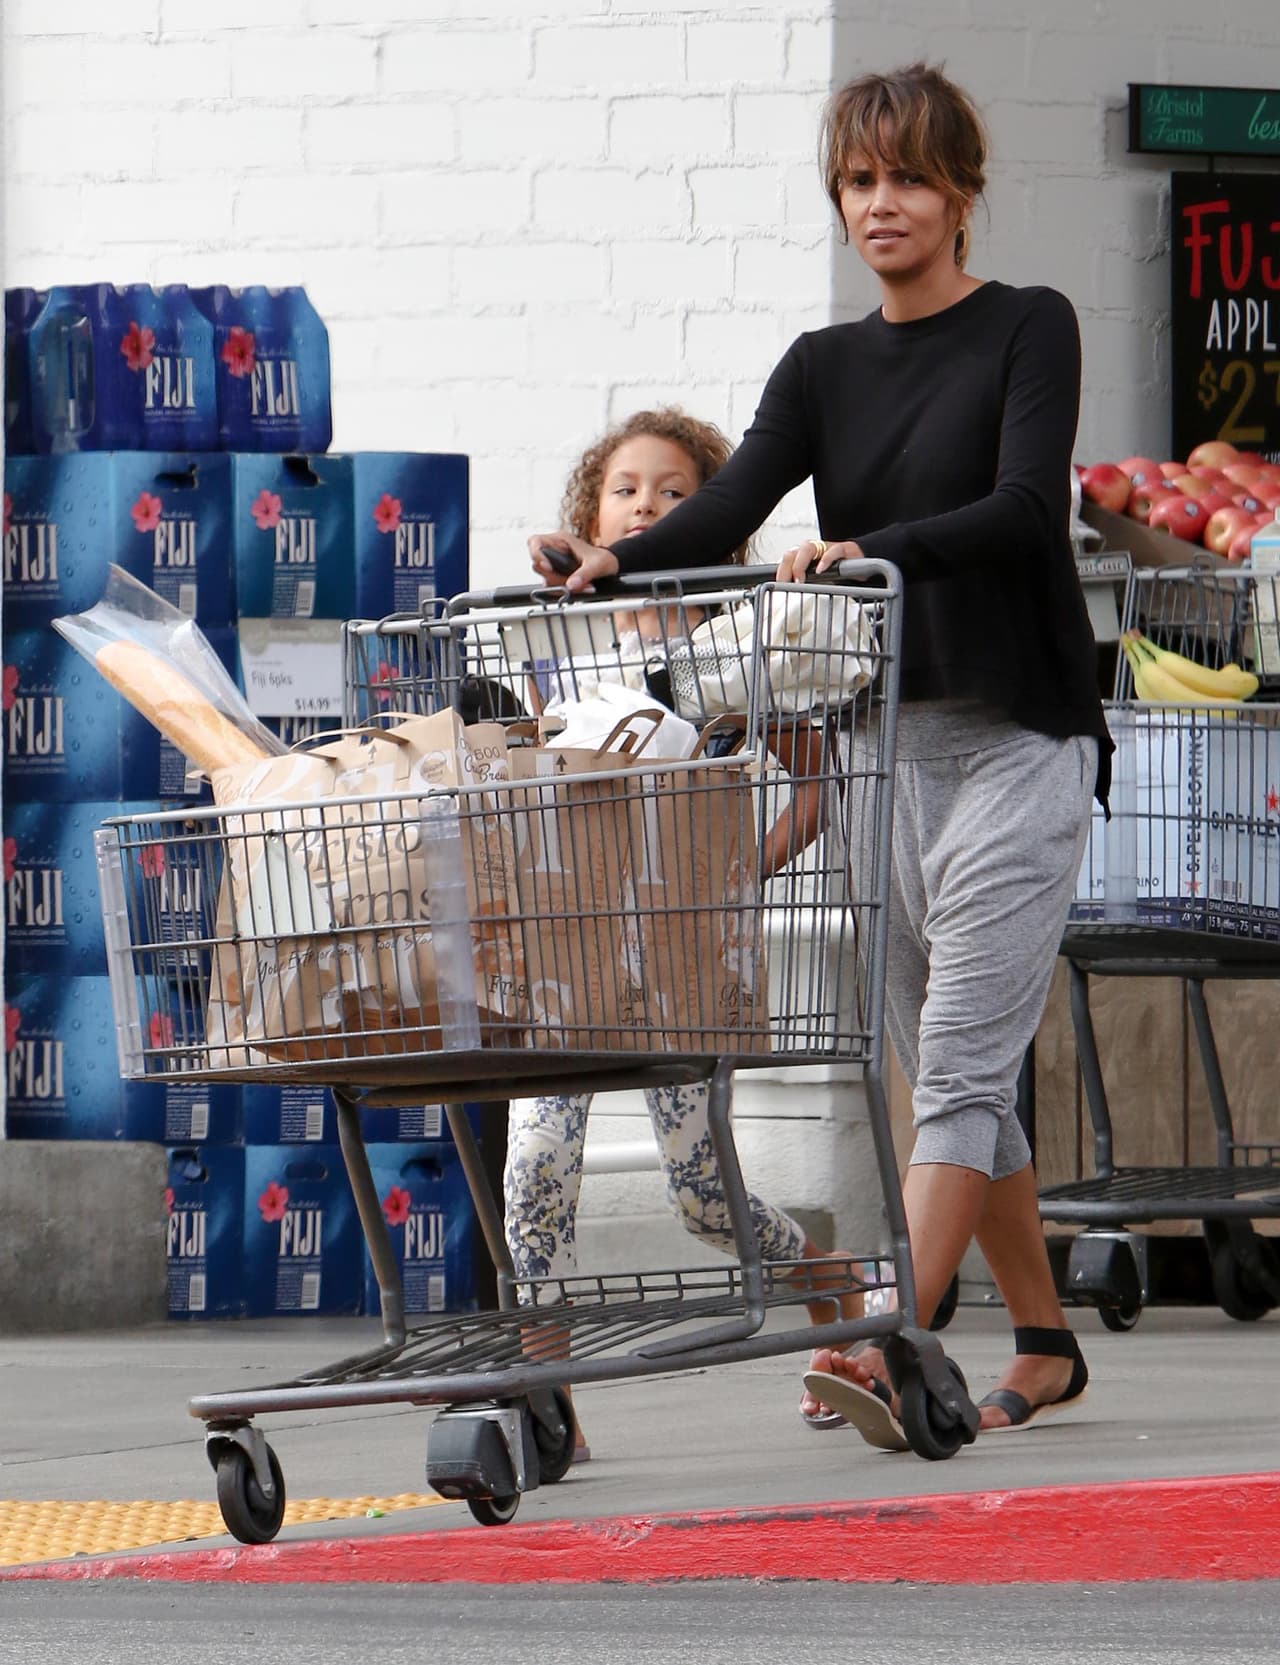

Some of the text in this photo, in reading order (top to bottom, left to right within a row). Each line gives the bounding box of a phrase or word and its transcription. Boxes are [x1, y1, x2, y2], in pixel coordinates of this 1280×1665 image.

[1148, 91, 1204, 118] Bristol
[1249, 95, 1280, 140] bes
[1149, 117, 1204, 144] Farms
[1206, 298, 1277, 352] APPL
[145, 357, 196, 408] FIJI
[251, 360, 300, 416] FIJI
[3, 523, 58, 583] FIJI
[153, 520, 196, 566] FIJI
[274, 518, 316, 563] FIJI
[394, 522, 435, 567] FIJI
[8, 697, 64, 755] FIJI
[295, 697, 329, 711] $14.99
[8, 870, 64, 926] FIJI
[8, 1040, 64, 1098] FIJI
[167, 1211, 206, 1257] FIJI
[279, 1210, 322, 1257] FIJI
[404, 1213, 444, 1259] FIJI
